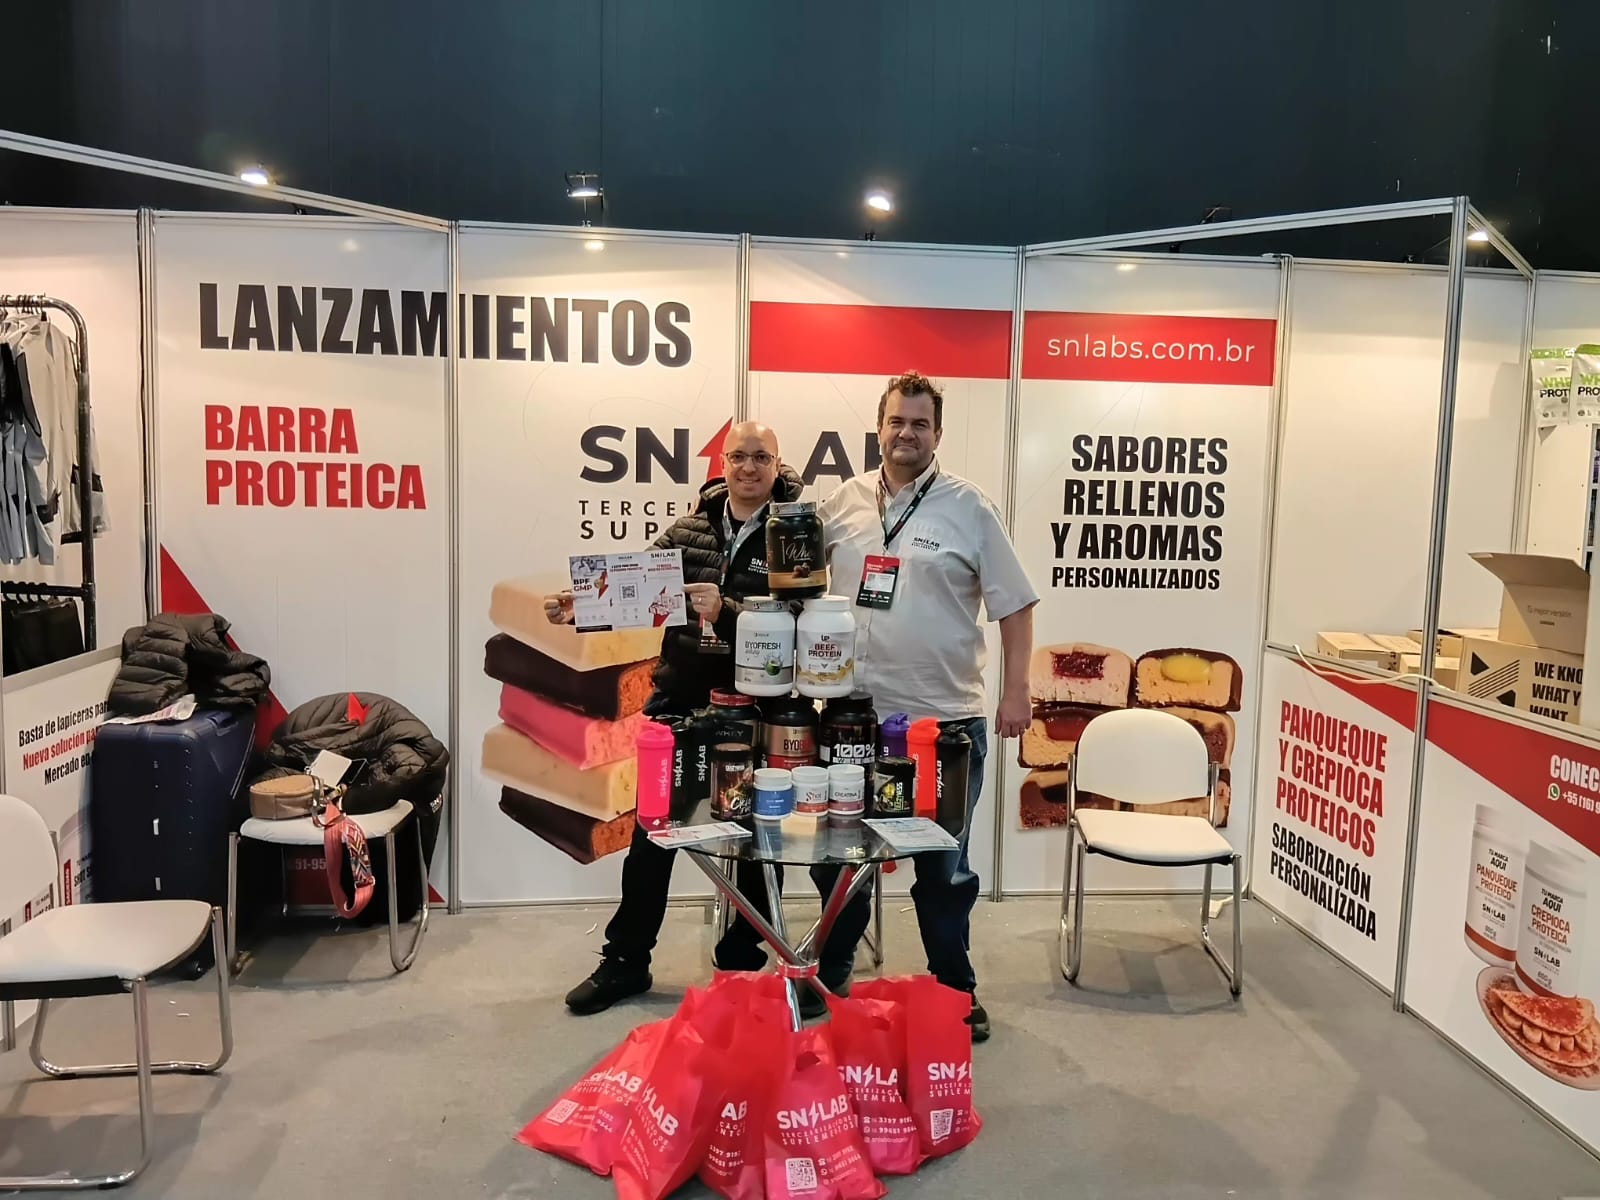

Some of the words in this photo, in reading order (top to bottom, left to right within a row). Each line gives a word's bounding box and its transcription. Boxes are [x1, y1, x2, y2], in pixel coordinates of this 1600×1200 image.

[200, 283, 692, 367] LANZAMIENTOS
[1047, 334, 1255, 362] snlabs.com.br
[205, 405, 358, 454] BARRA
[1071, 434, 1229, 475] SABORES
[206, 460, 426, 510] PROTEICA
[1063, 479, 1225, 518] RELLENOS
[1050, 522, 1071, 559] Y
[1077, 523, 1223, 562] AROMAS
[1052, 566, 1220, 590] PERSONALIZADOS
[815, 643, 836, 651] BEEF
[1534, 661, 1555, 679] WE
[1532, 683, 1570, 705] WHAT
[19, 727, 44, 747] Basta
[45, 720, 56, 737] de
[57, 705, 94, 732] lapiceras
[1280, 700, 1387, 773] PANQUEQUE
[23, 747, 49, 770] Nueva
[51, 732, 85, 758] solución
[834, 743, 875, 758] 100%
[44, 757, 80, 785] Mercado
[1279, 738, 1289, 772] Y
[1291, 745, 1383, 817] CREPIOCA
[1562, 791, 1578, 806] +55
[1276, 776, 1376, 858] PROTEICOS
[1476, 864, 1518, 892] PANQUEQUE
[1481, 878, 1512, 901] PROTEICO
[1270, 851, 1376, 941] PERSONALIZADA
[1543, 897, 1561, 913] AQUI
[1531, 904, 1570, 934] CREPIOCA
[1532, 918, 1567, 945] PROTEICA
